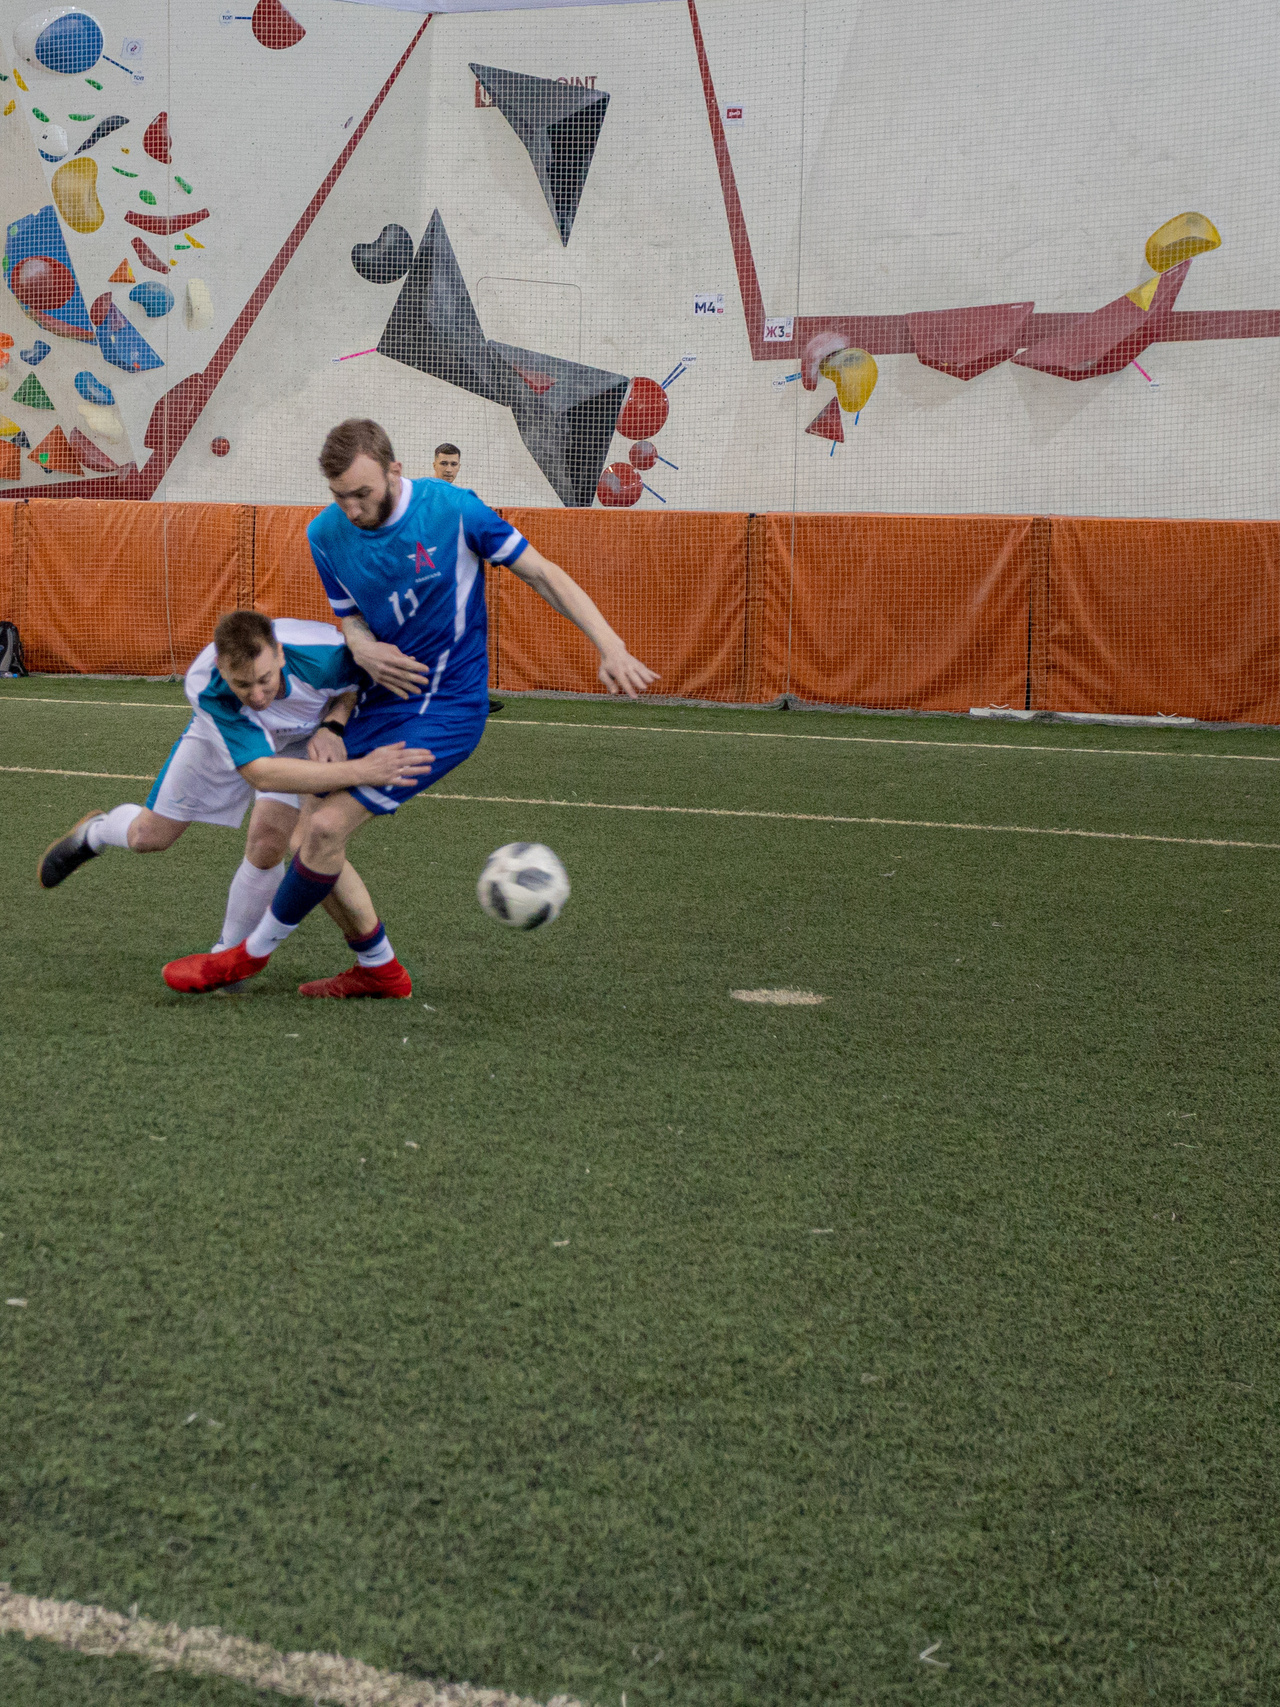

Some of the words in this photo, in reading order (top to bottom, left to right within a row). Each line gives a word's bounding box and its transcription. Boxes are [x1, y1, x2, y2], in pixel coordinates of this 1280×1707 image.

[694, 301, 716, 314] М4
[765, 325, 785, 338] Ж3
[388, 588, 420, 626] 11
